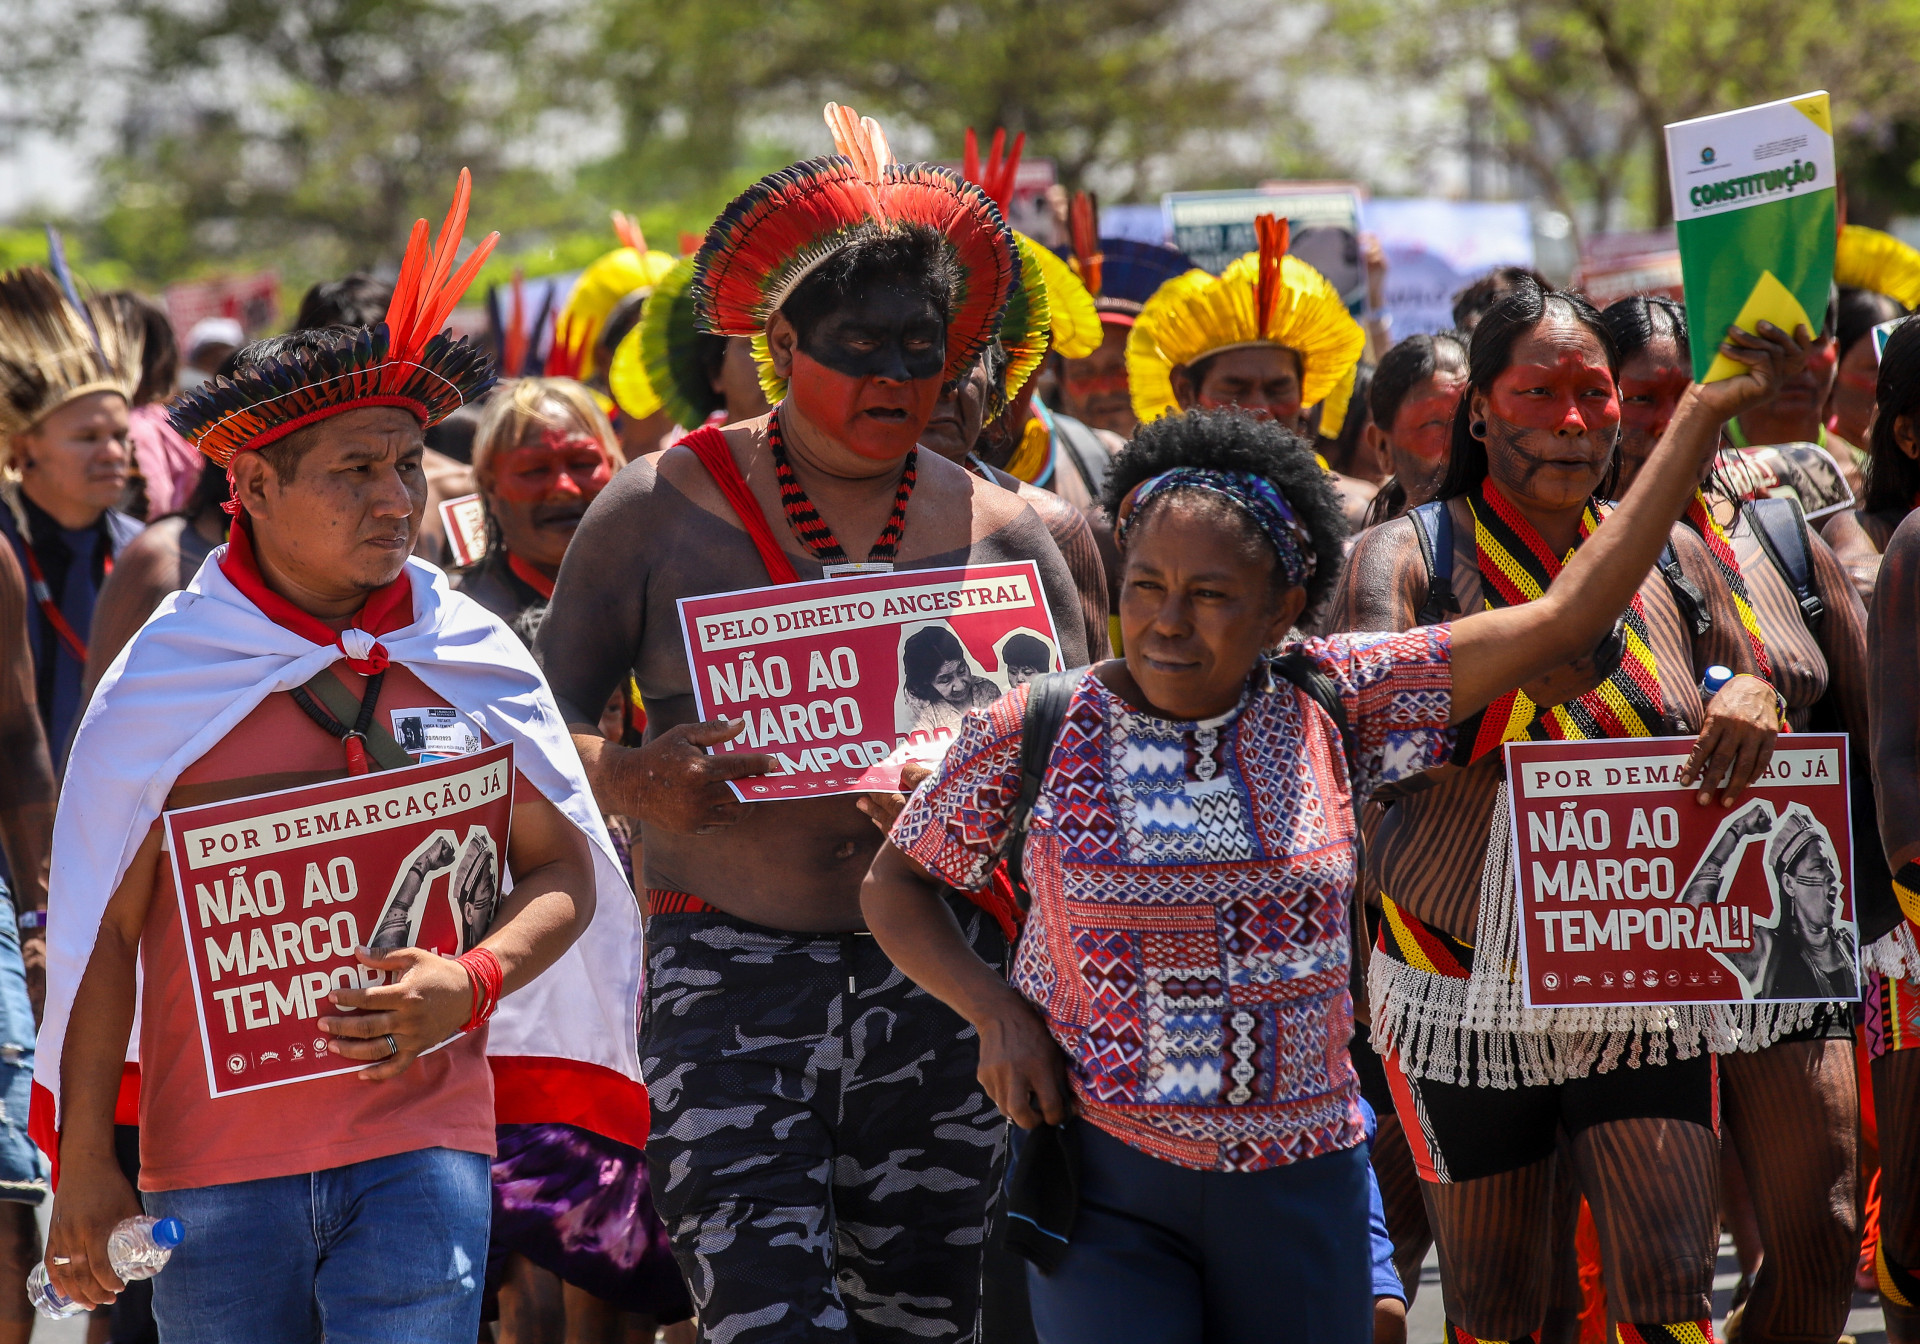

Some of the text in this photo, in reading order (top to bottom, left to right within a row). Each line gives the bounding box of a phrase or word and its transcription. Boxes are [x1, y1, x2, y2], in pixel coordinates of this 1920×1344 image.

[1690, 159, 1817, 207] CONSTITUIÇÃO
[704, 584, 1026, 644] PELO DIREITO ANCESTRAL
[707, 646, 860, 706] NÃO AO
[716, 696, 863, 752] MARCO
[1536, 769, 1592, 790] POR
[1801, 754, 1830, 778] JÁ
[199, 768, 502, 858] POR DEMARCAÇÃO JÁ
[1527, 801, 1679, 852] NÃO AO
[195, 856, 359, 929] NÃO AO
[1532, 857, 1675, 903] MARCO
[205, 911, 360, 982] MARCO
[1535, 906, 1751, 953] TEMPORAL!
